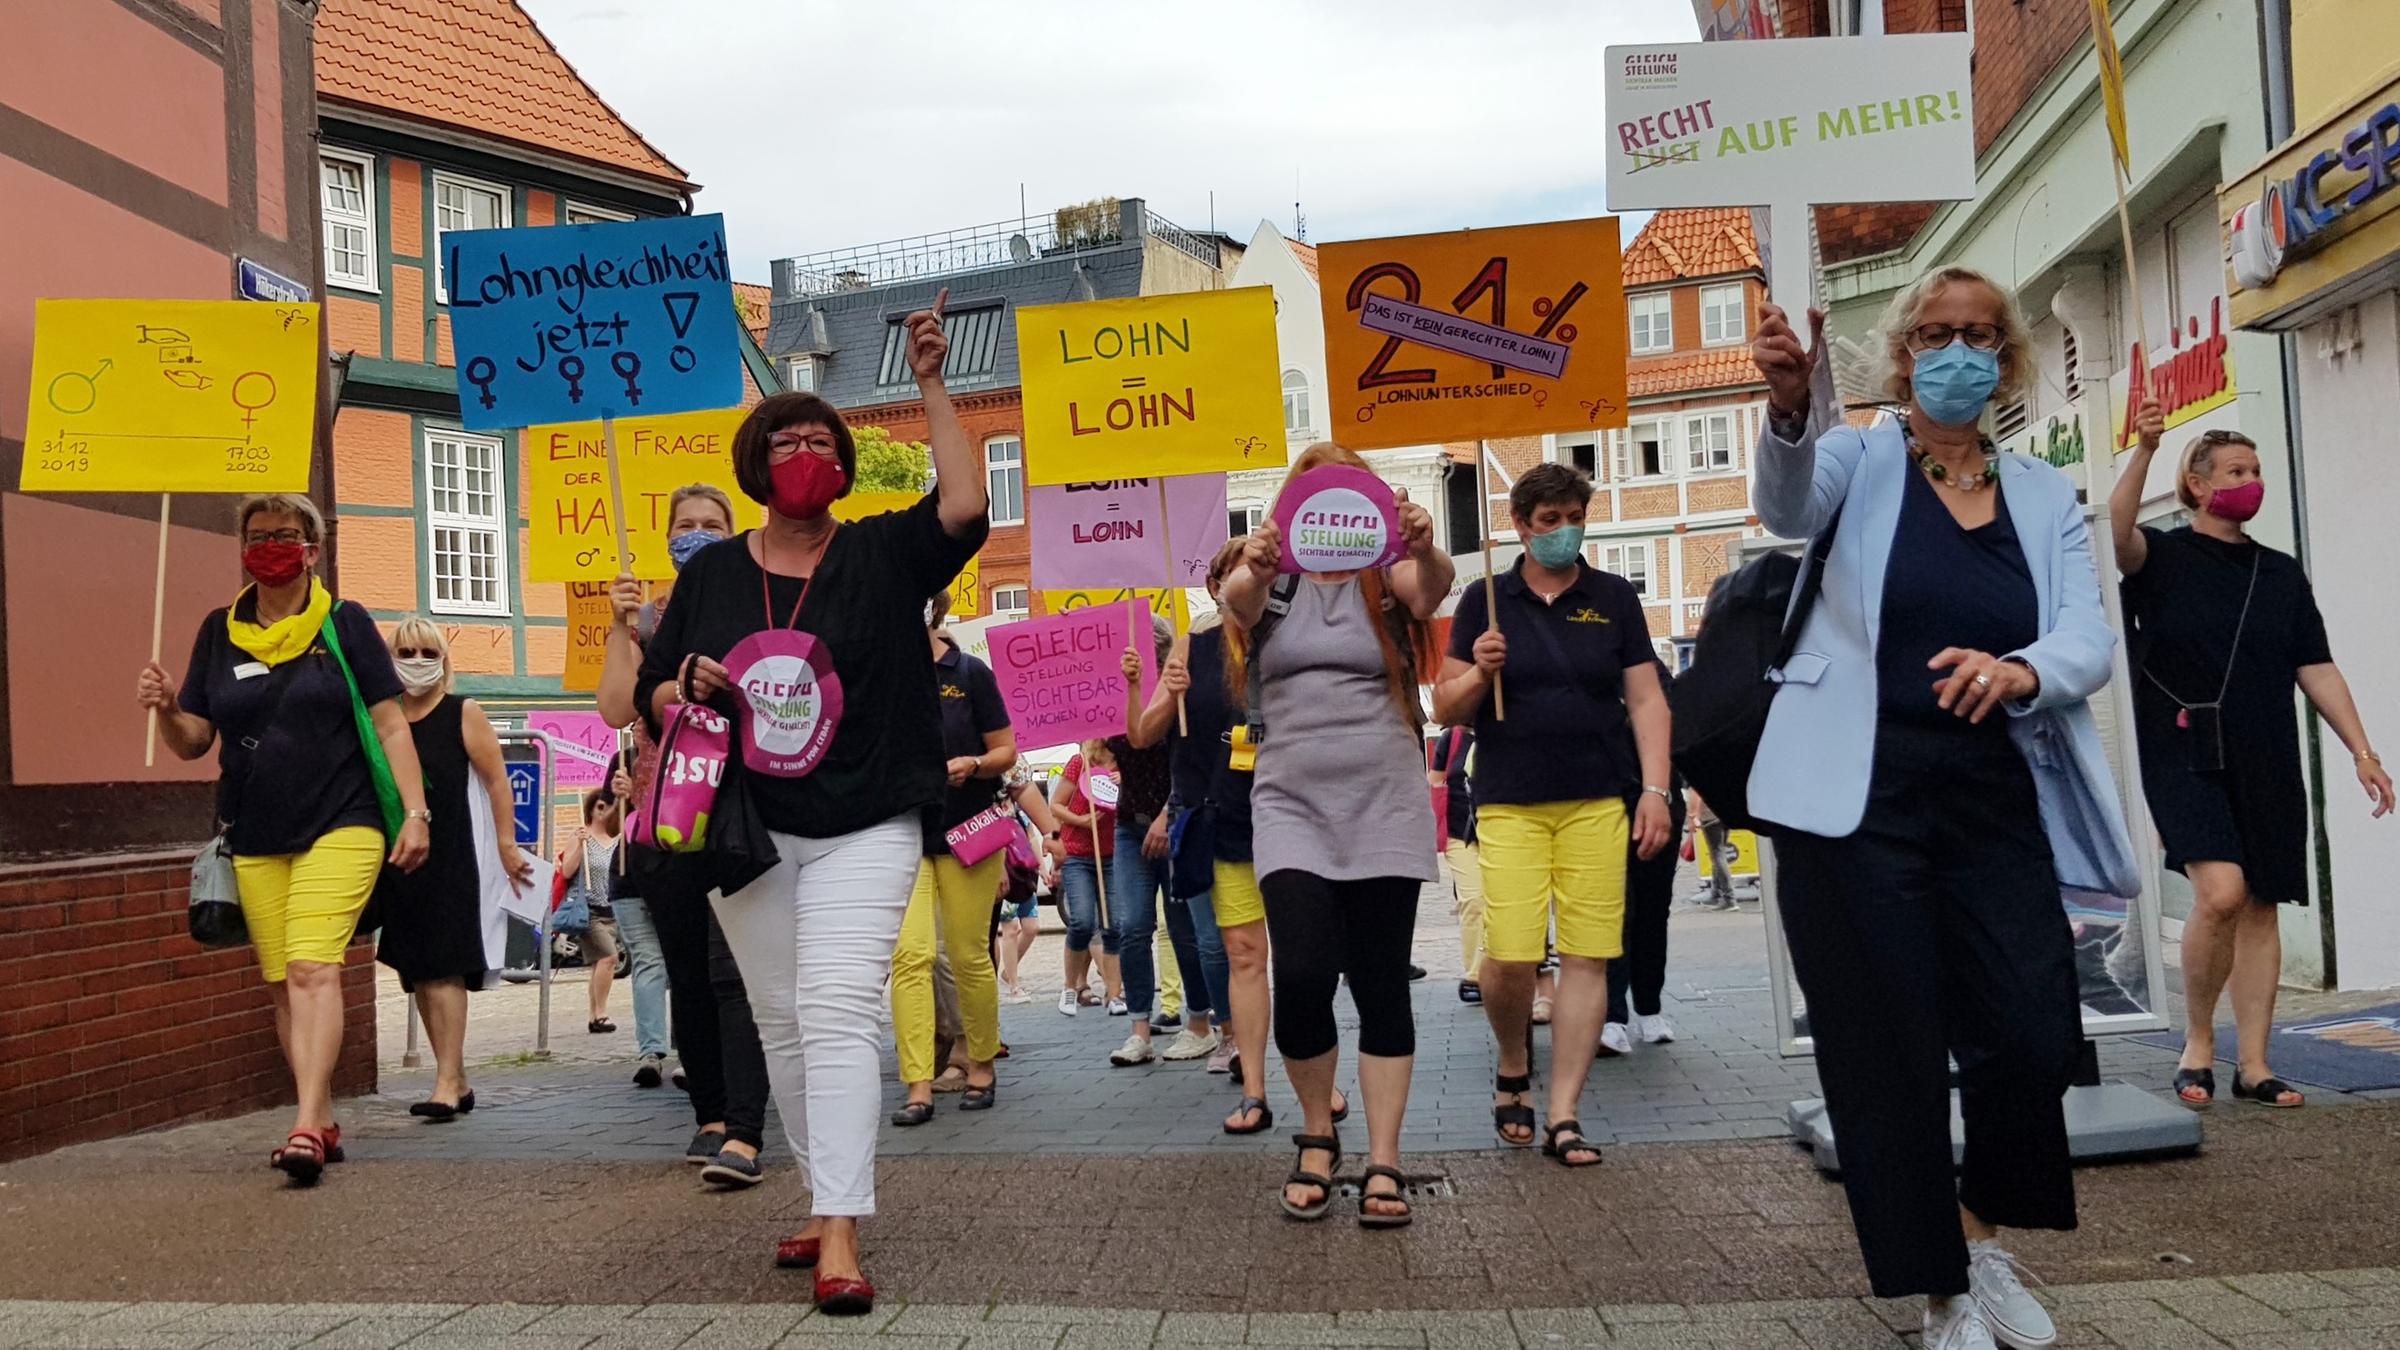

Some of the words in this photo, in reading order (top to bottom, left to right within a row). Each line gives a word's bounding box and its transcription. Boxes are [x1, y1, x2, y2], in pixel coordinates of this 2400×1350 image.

[1625, 64, 1677, 76] STELLUNG
[1618, 100, 1714, 152] RECHT
[1717, 116, 1798, 157] AUF
[1818, 90, 1963, 141] MEHR!
[450, 231, 731, 314] Lohngleichheit
[516, 310, 629, 372] jetzt
[1059, 318, 1190, 364] LOHN
[1366, 302, 1390, 319] DAS
[1394, 311, 1413, 325] IST
[1413, 315, 1444, 335] KEIN
[1443, 325, 1518, 351] GERECHTER
[1521, 344, 1556, 364] LOHN!
[1378, 383, 1531, 404] LOHNUNTERSCHIED
[1069, 387, 1195, 436] LOHN
[634, 430, 721, 456] FRAGE
[41, 457, 89, 472] 2019
[226, 462, 269, 473] 2020
[564, 472, 602, 486] DER
[556, 493, 667, 537] HAT
[1072, 520, 1143, 543] LOHN
[1300, 529, 1377, 549] STELLUNG
[1299, 547, 1334, 557] SICHTBAR
[1018, 661, 1094, 684] STELLUNG
[1012, 677, 1124, 712] SICHTBAR
[1026, 708, 1079, 729] MACHEN
[769, 760, 780, 769] IM
